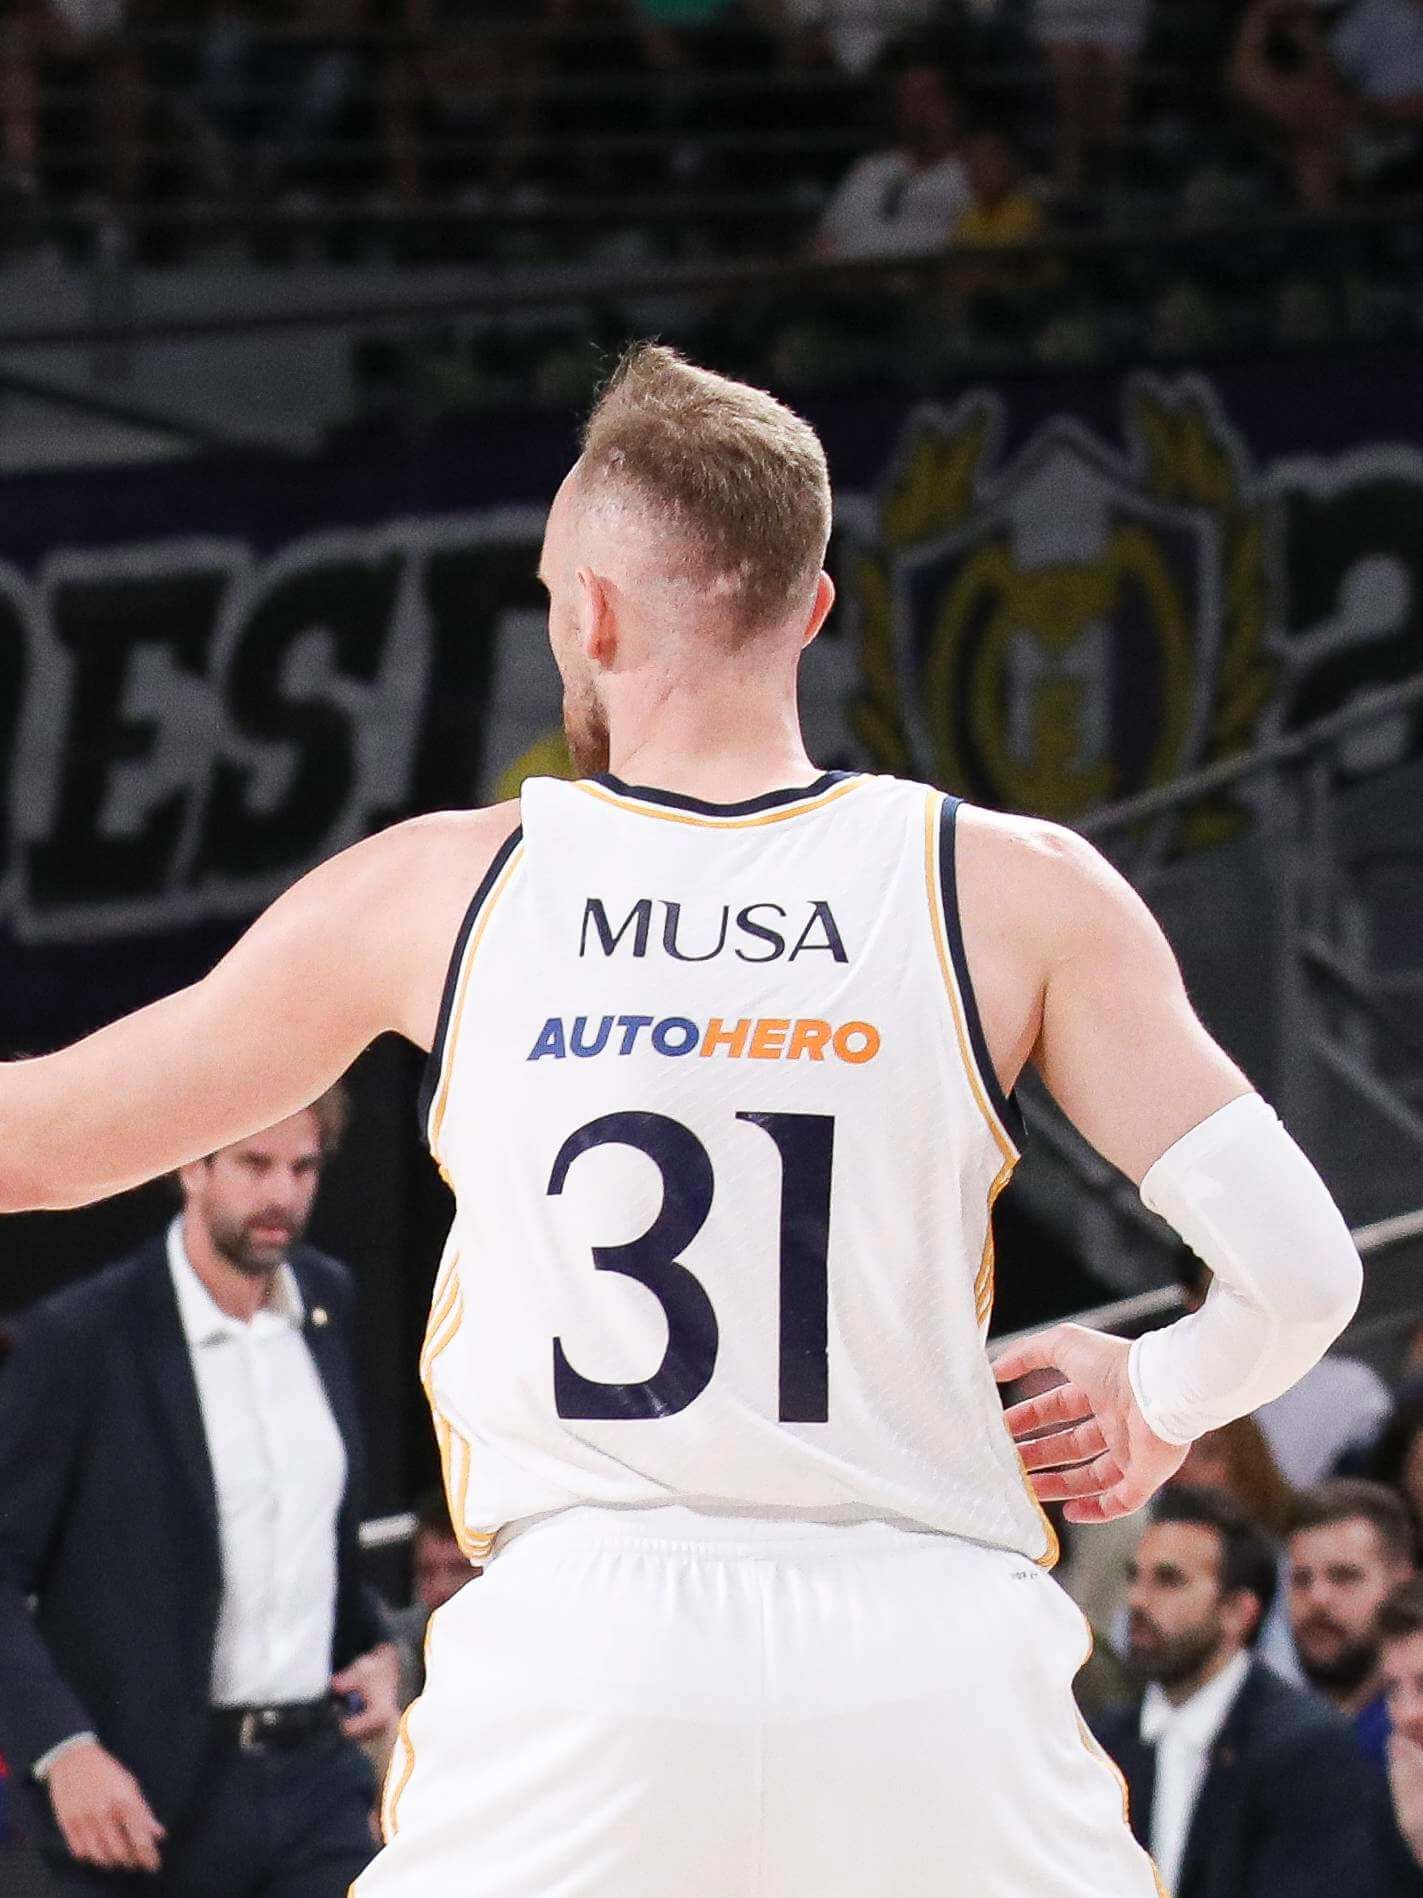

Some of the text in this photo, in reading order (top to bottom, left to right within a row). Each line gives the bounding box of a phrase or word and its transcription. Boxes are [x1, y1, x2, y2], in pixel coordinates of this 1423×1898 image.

[579, 898, 849, 963] MUSA
[527, 1016, 880, 1064] AUTOHERO
[546, 1110, 835, 1423] 31
